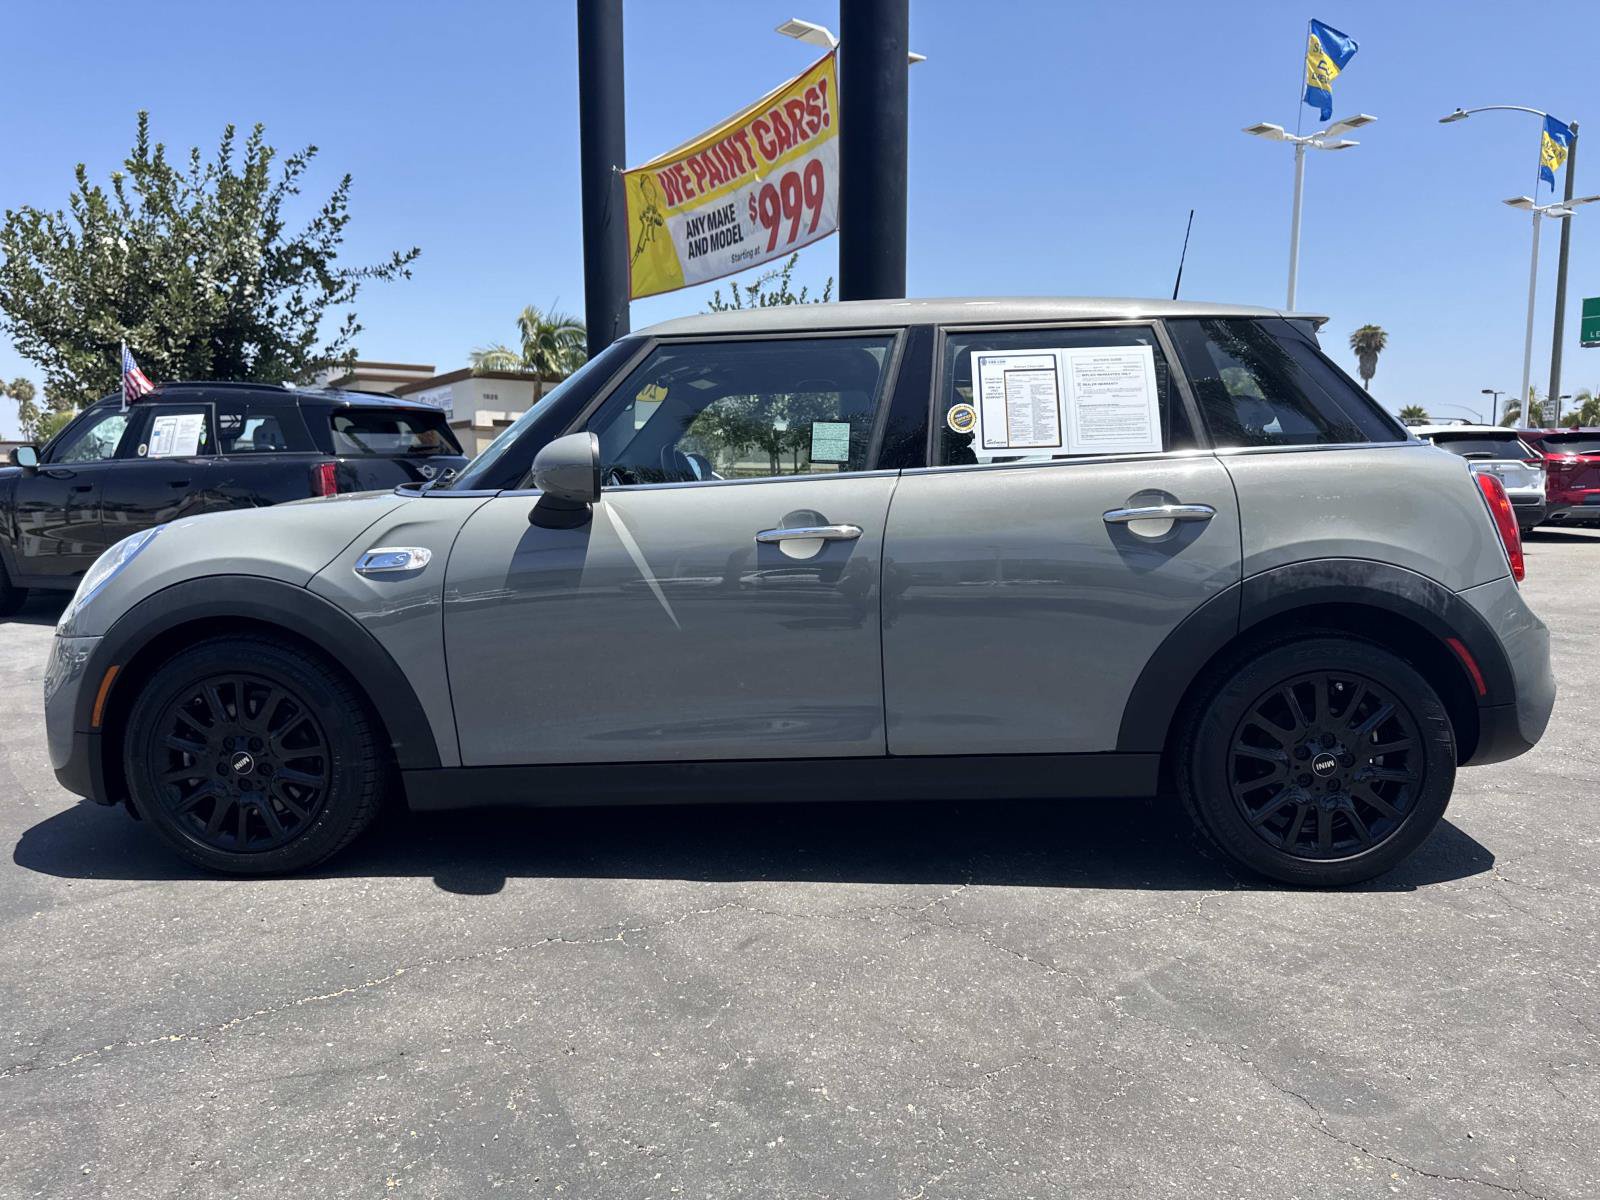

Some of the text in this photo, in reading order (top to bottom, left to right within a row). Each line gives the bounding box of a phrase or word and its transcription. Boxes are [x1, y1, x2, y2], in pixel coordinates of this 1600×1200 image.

[656, 78, 831, 207] WE PAINT CARS!
[685, 203, 737, 240] ANY MAKE
[748, 158, 825, 253] $999
[687, 223, 744, 260] AND MODEL
[731, 247, 761, 264] Starting at
[233, 756, 250, 771] MINI
[1315, 760, 1335, 771] MINI
